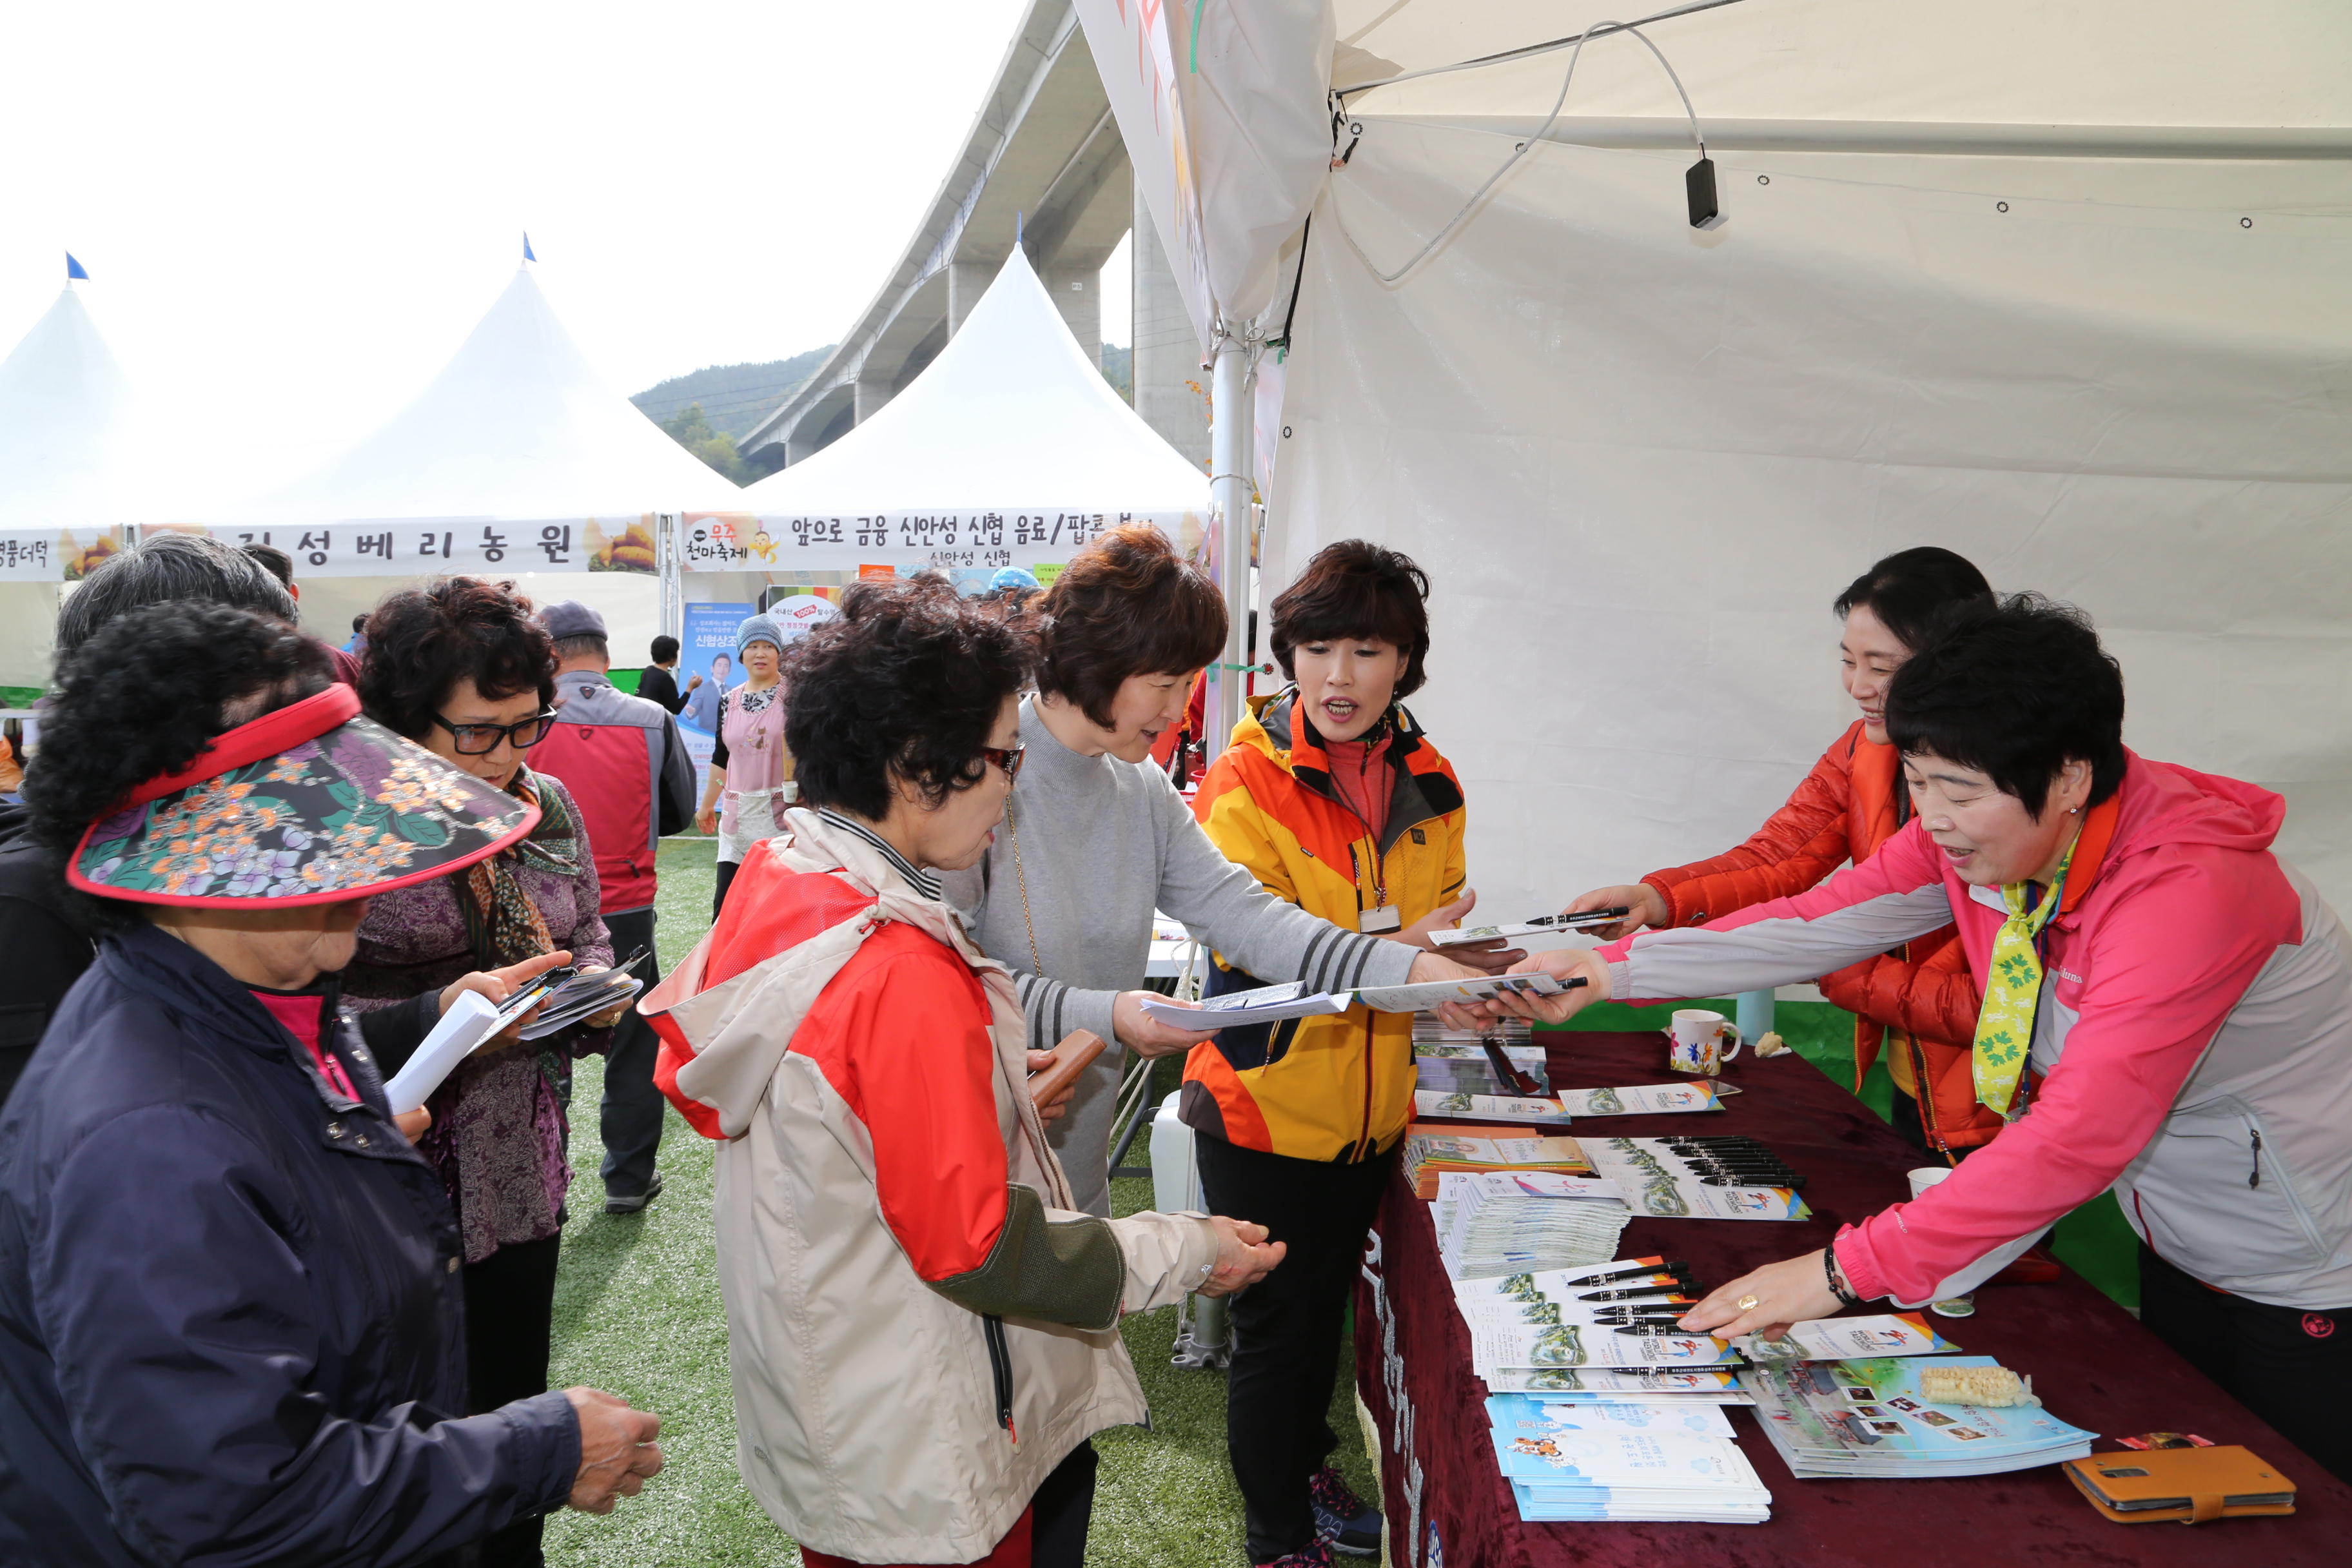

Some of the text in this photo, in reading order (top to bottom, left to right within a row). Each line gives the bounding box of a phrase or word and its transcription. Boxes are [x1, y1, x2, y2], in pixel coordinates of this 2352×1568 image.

[710, 524, 737, 543] 무주
[792, 518, 844, 546] 앞으로
[856, 513, 889, 547] 금융
[900, 516, 957, 547] 신안성
[968, 513, 1003, 545] 신협
[687, 540, 747, 562] 천마축제
[930, 550, 1010, 567] 신안성 신협
[796, 606, 816, 618] 100%
[1650, 1337, 1661, 1354] WORLD
